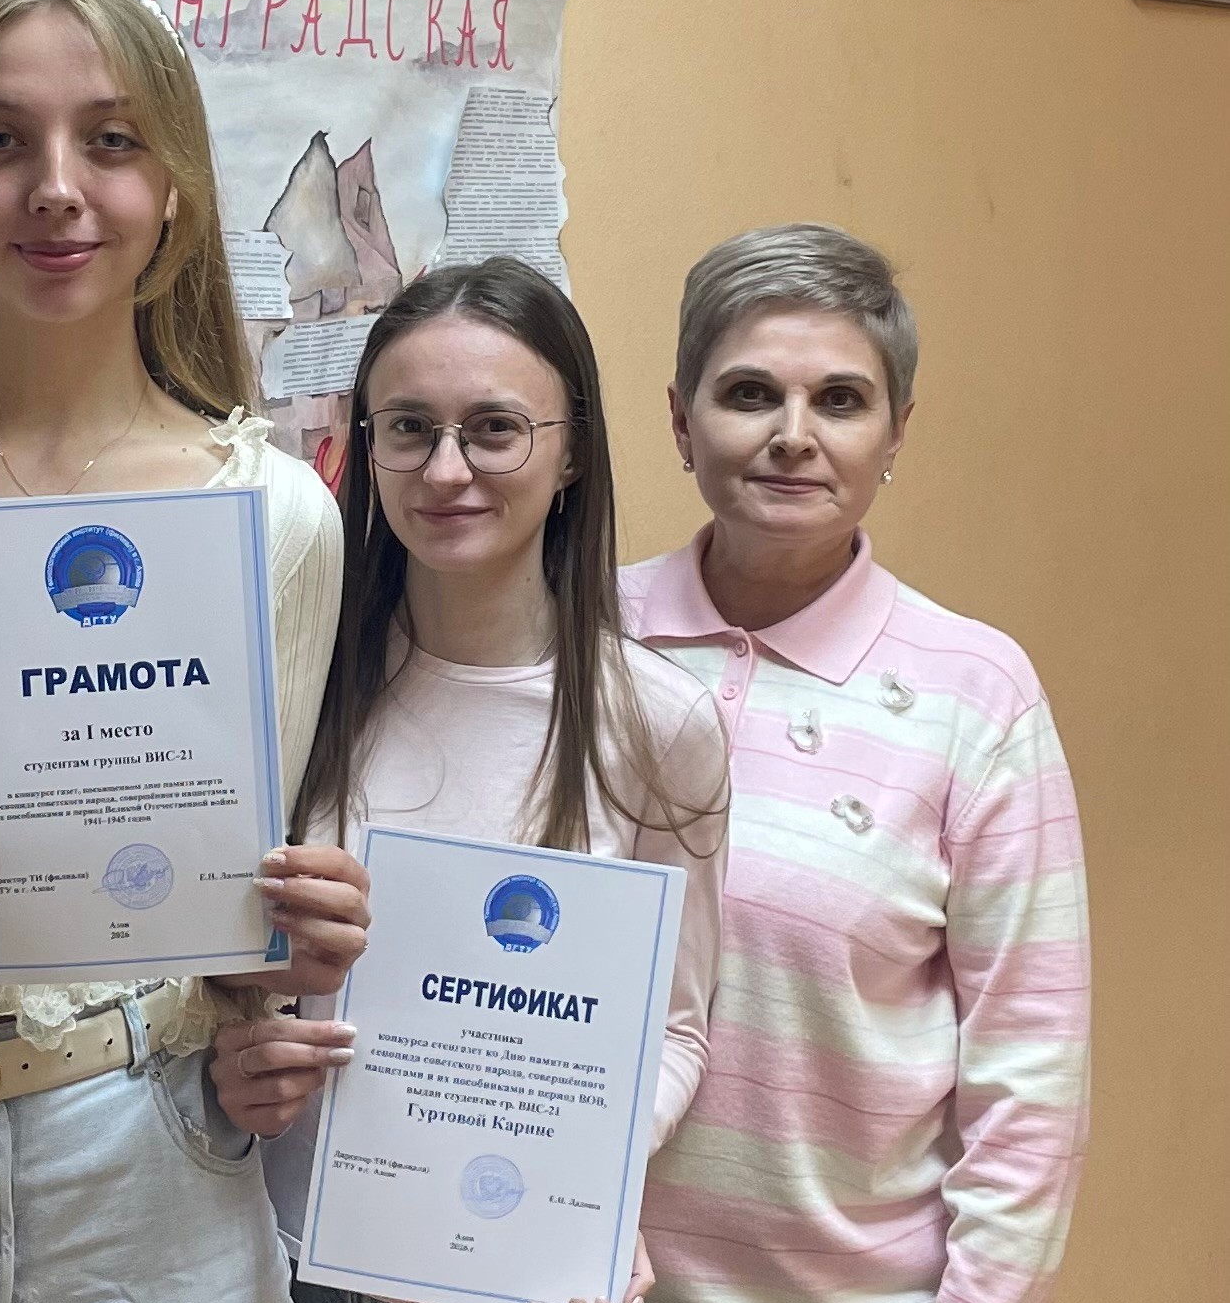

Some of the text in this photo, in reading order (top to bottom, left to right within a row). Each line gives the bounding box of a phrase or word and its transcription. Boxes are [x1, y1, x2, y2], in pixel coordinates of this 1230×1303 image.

[81, 615, 117, 627] ДГТУ
[21, 658, 210, 697] ГРАМОТА
[61, 724, 153, 741] за I место
[23, 749, 193, 773] студентам группы ВИС-21
[421, 974, 599, 1024] СЕРТИФИКАТ
[406, 1102, 554, 1137] Гуртовой Карине
